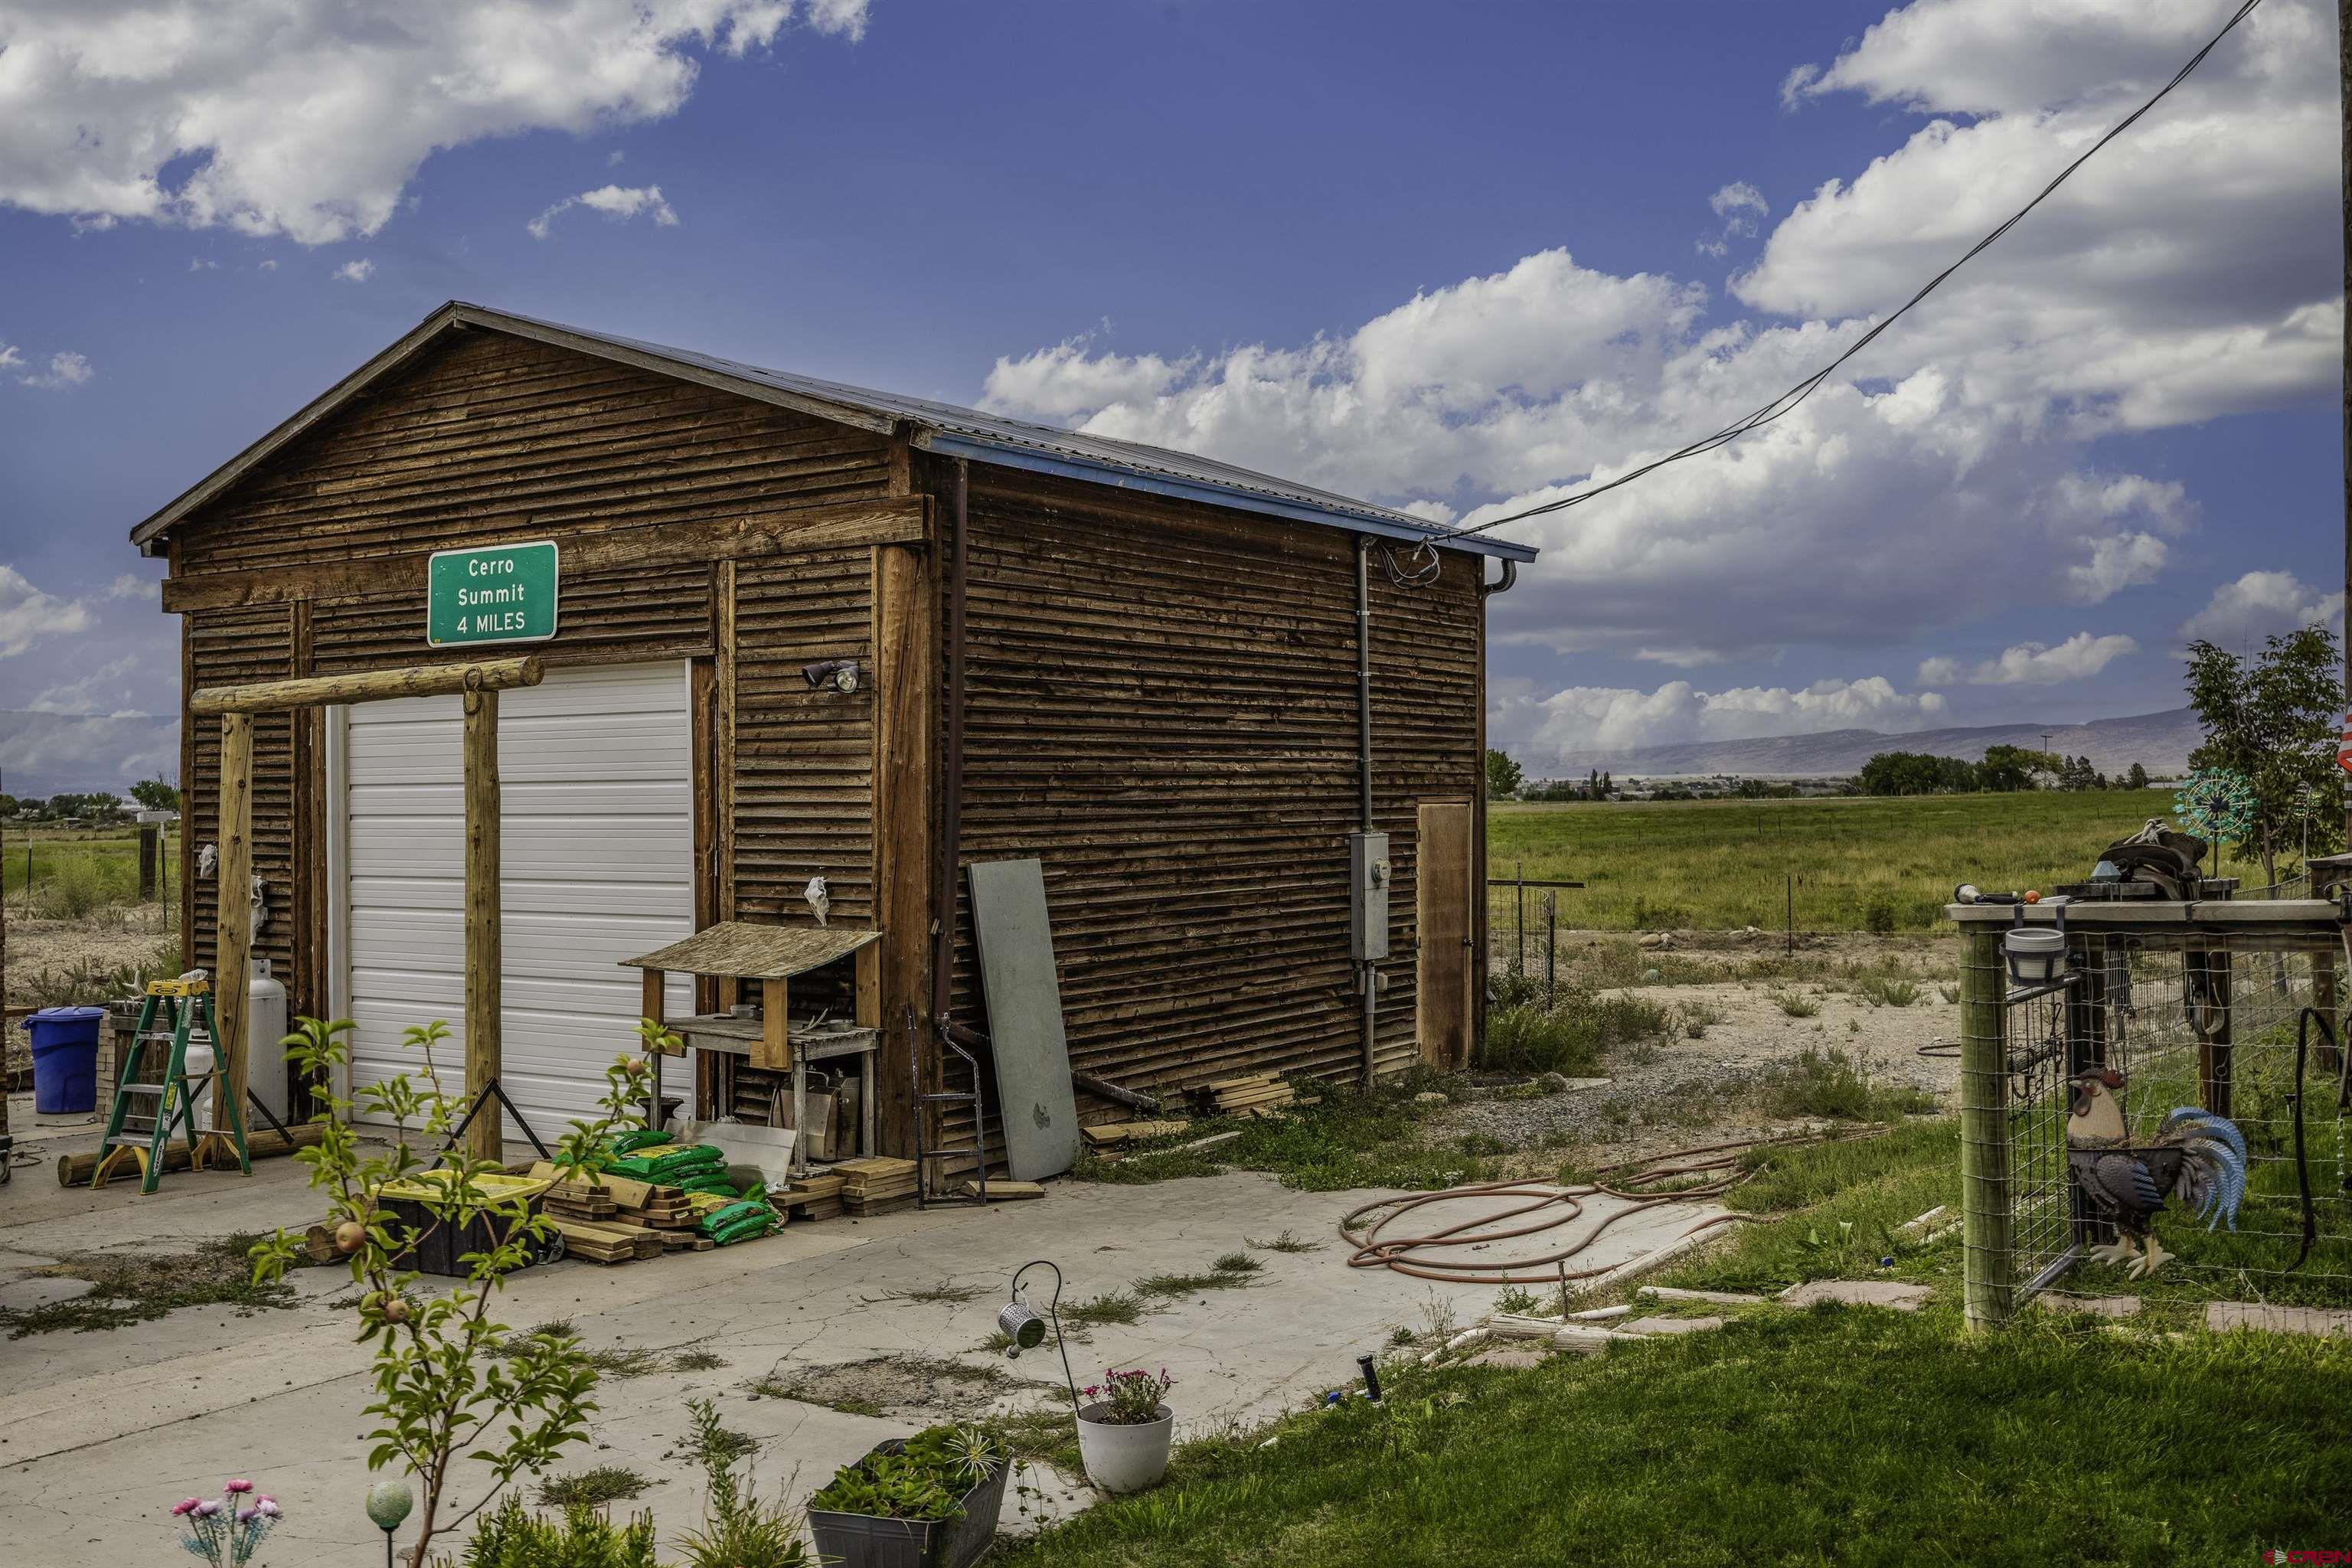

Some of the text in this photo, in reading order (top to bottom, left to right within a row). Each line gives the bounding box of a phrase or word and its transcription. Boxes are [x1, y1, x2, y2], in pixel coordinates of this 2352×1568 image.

[469, 559, 514, 577] Cerro
[458, 583, 524, 606] Summit
[456, 612, 525, 634] 4 MILES
